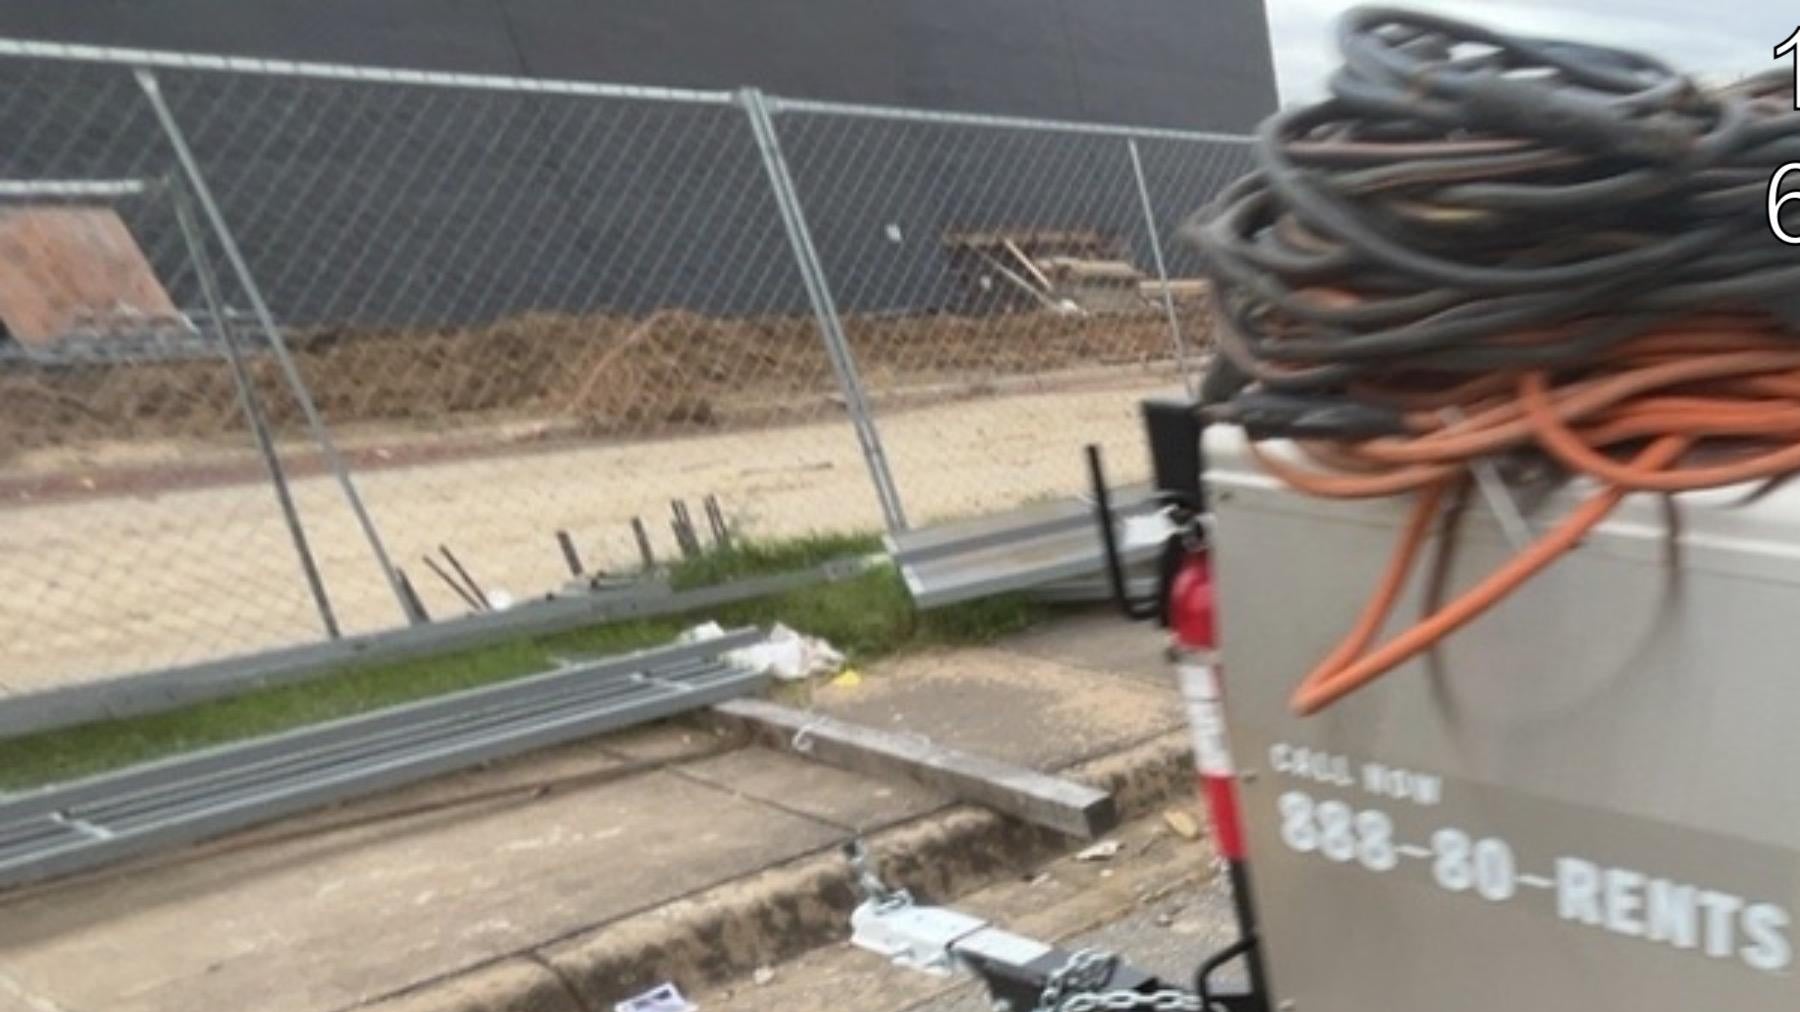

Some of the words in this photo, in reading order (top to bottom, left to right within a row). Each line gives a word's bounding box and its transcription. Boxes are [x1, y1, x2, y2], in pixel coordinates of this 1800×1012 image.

[1268, 742, 1357, 788] CALL
[1361, 762, 1442, 806] NOW
[1277, 790, 1793, 971] 888-80-RENTS
